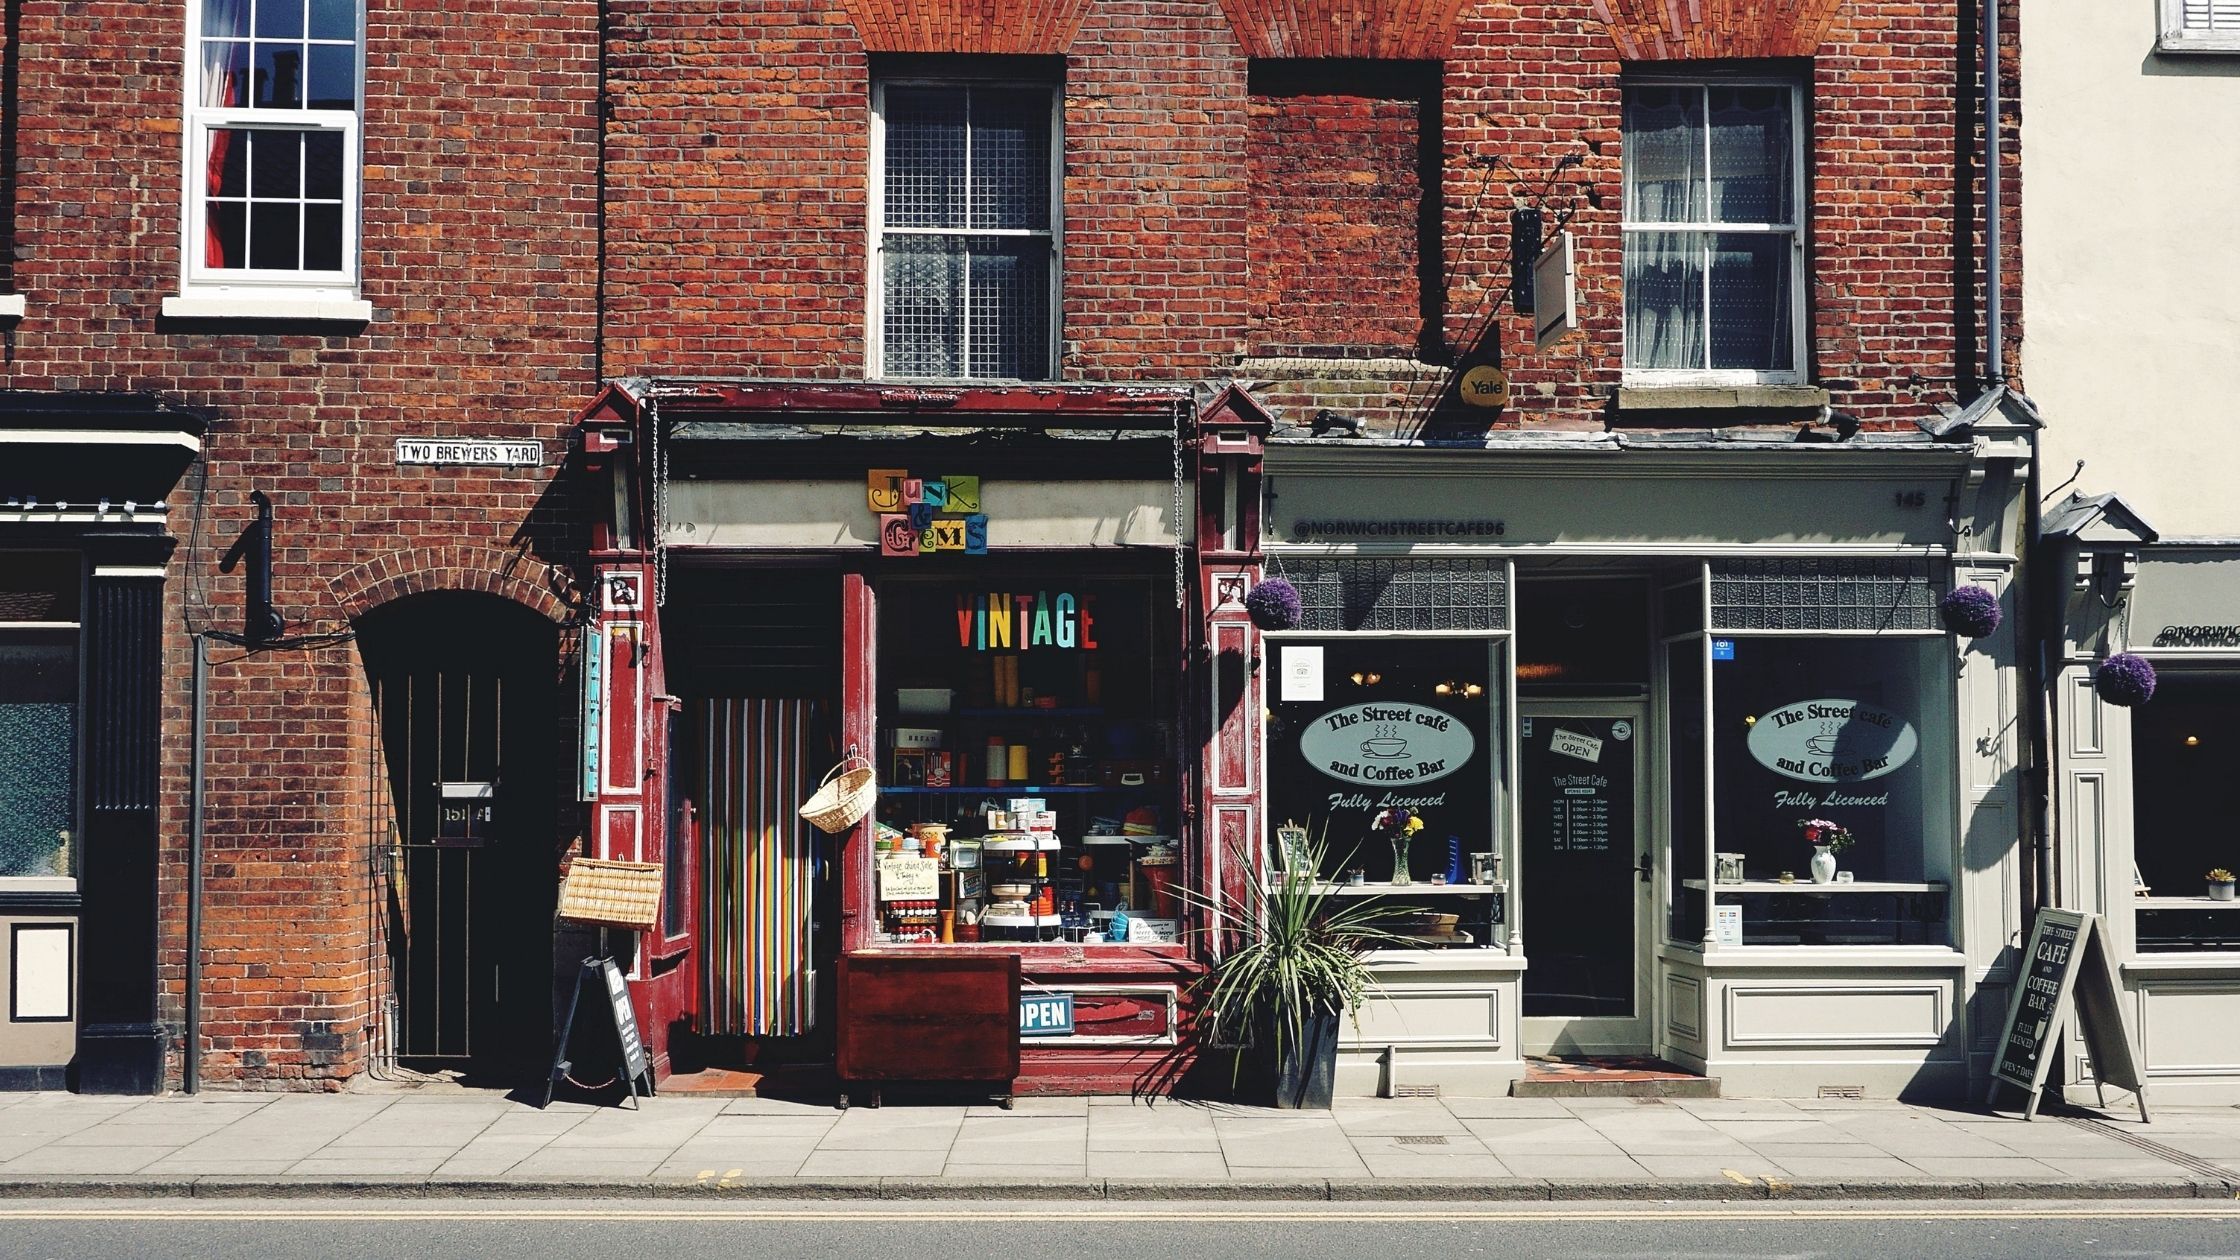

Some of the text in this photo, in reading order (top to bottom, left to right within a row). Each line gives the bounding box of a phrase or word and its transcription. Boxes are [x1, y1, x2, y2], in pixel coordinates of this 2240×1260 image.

[1471, 380, 1503, 395] Yale
[401, 445, 538, 461] TWO BREWERS YARD
[1294, 520, 1505, 537] @NORWICHSTREETCAFE96
[956, 591, 1098, 650] VINTAGE
[1325, 706, 1450, 732] The Street café
[1771, 709, 1805, 729] The
[1807, 703, 1856, 720] Street
[1562, 743, 1590, 757] OPEN
[1330, 759, 1445, 780] and Coffee Bar
[1776, 755, 1888, 777] and Coffee Bar
[1567, 774, 1590, 785] Street
[1328, 792, 1446, 811] Fully Licenced
[1774, 790, 1888, 809] Fully Licenced
[2043, 925, 2077, 940] THE STREET
[2037, 941, 2070, 965] CAFÉ
[2027, 975, 2059, 996] COFFEE
[2028, 993, 2047, 1011] BAR
